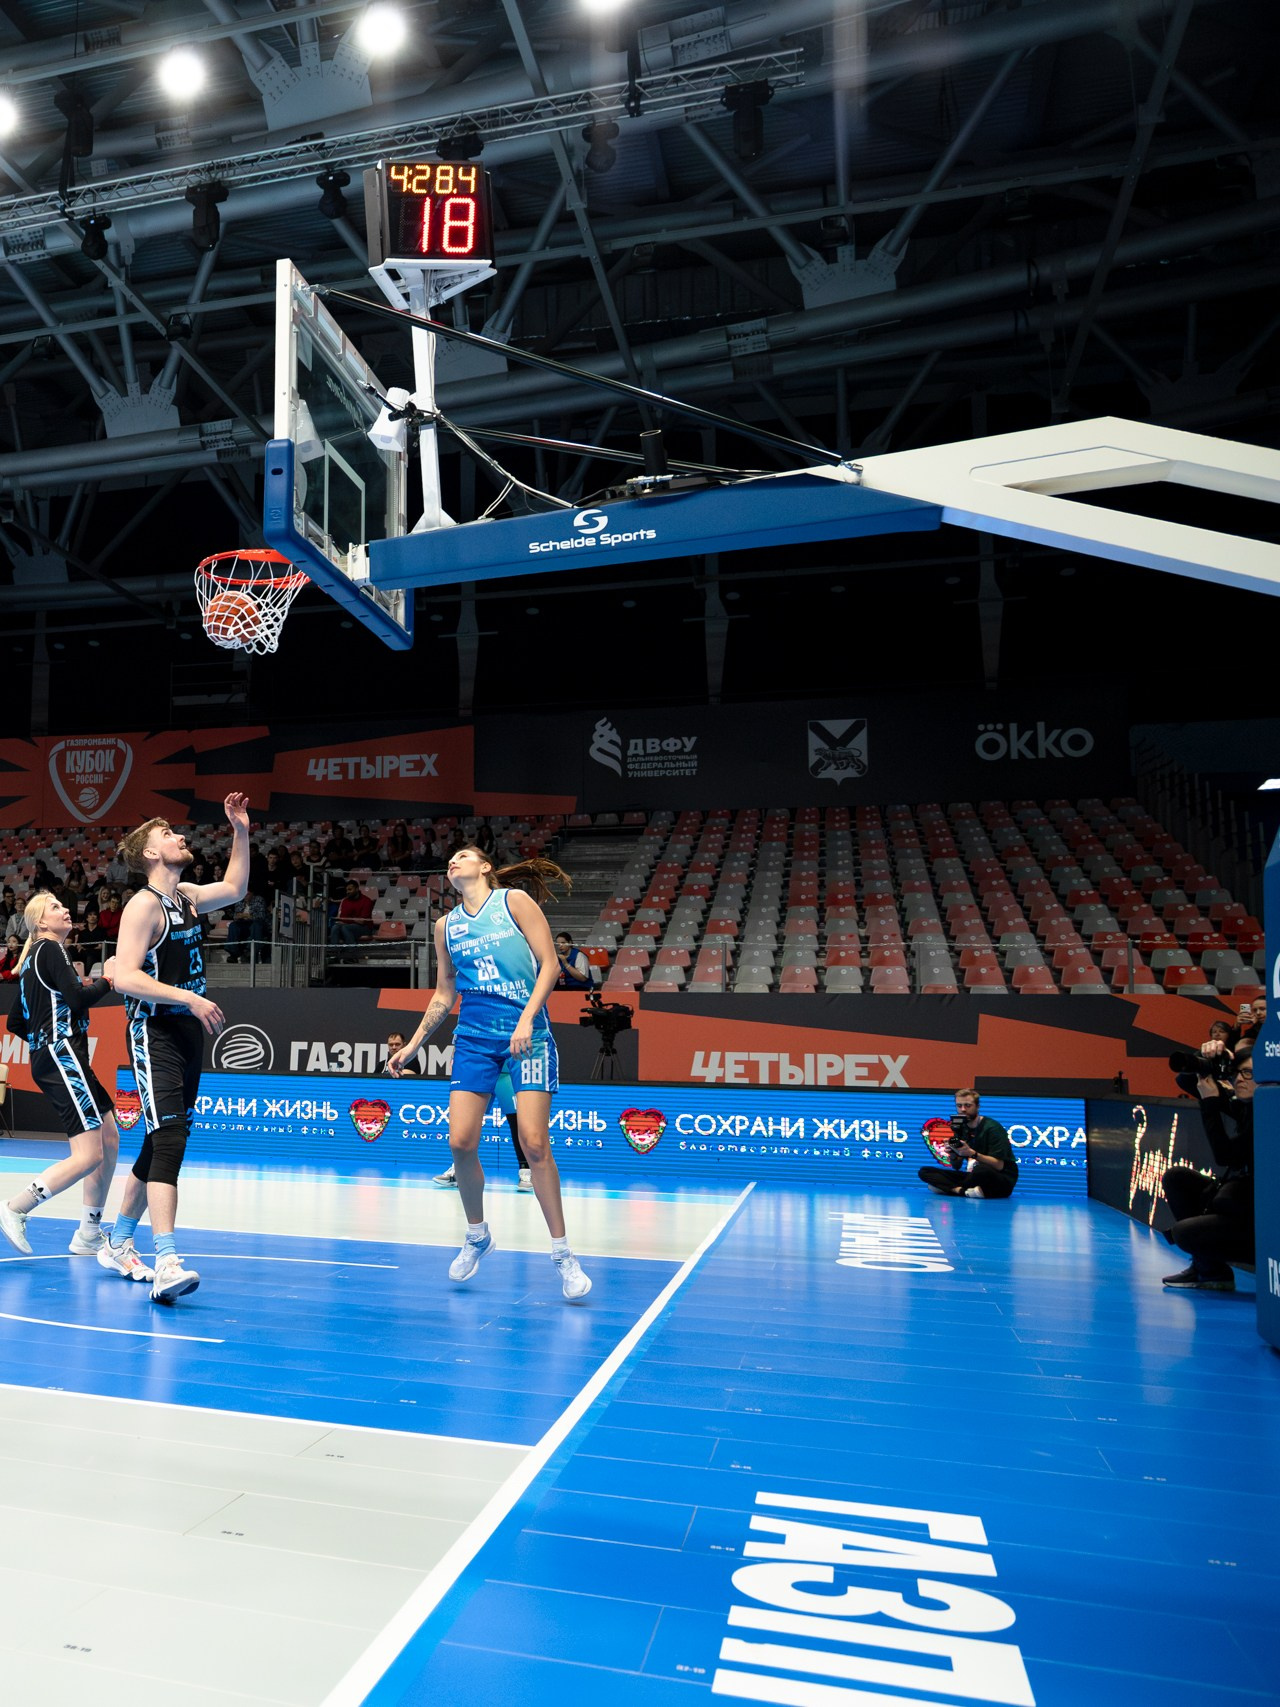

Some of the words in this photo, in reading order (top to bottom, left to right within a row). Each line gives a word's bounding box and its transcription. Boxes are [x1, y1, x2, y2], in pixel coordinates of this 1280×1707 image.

[390, 165, 476, 194] 4:28.4
[422, 197, 475, 253] 18
[528, 536, 596, 553] Schelde
[600, 529, 656, 546] Sports
[66, 737, 117, 747] ГАЗПРОМБАНК
[627, 736, 698, 756] ДВФУ
[65, 749, 116, 774] КУБОК
[626, 761, 698, 770] ФЕДЕРАЛЬНЫЙ
[627, 768, 698, 778] УНИВЕРСИТЕТ
[75, 773, 104, 785] РОССИИ
[462, 941, 500, 957] МАТЧ
[473, 954, 500, 981] 88
[290, 1041, 455, 1075] ГАЗПМ
[521, 1058, 543, 1085] 88
[263, 1098, 339, 1121] ЖИЗНЬ
[548, 1109, 607, 1132] ИЗНЬ
[194, 1122, 293, 1133] творительный
[301, 1125, 335, 1137] фонд
[675, 1113, 805, 1139] СОХРАНИ
[812, 1117, 908, 1143] ЖИЗНЬ
[1005, 1124, 1087, 1149] ОХРА
[565, 1136, 603, 1149] фонд
[862, 1148, 904, 1161] фонд
[827, 1211, 955, 1273] ДИНАМО
